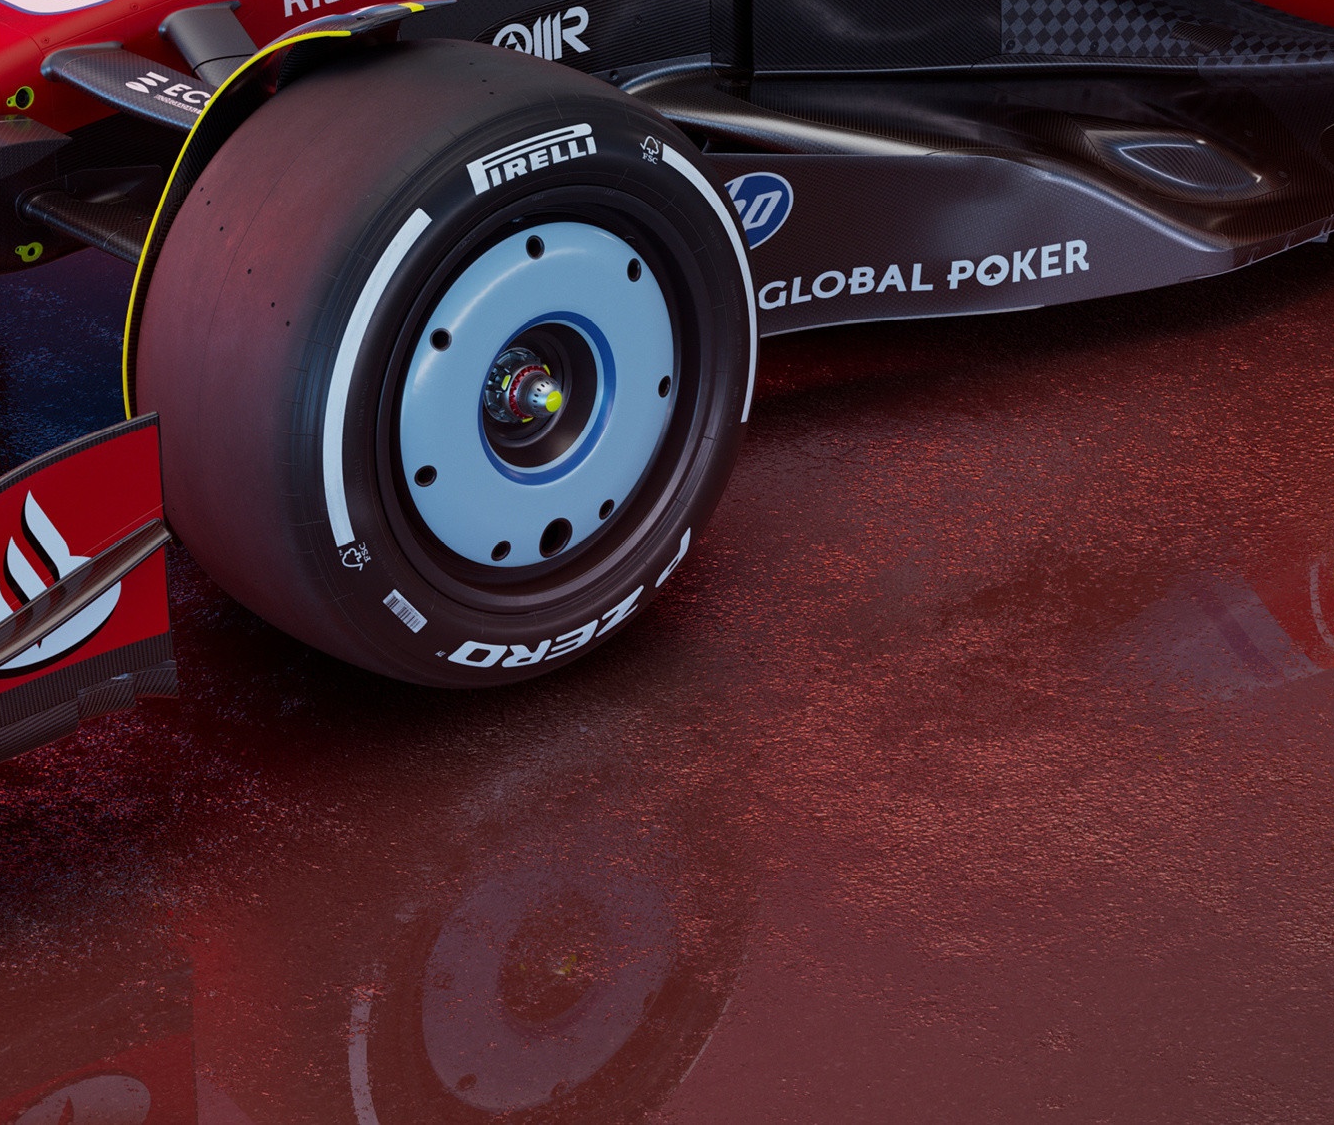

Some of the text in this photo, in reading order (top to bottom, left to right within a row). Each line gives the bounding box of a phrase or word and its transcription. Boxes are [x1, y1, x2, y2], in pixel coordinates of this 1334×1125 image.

[163, 83, 212, 107] EC
[467, 122, 597, 196] PIRELLI
[642, 152, 658, 165] FSC
[758, 263, 933, 310] GLOBAL
[947, 239, 1090, 290] POKER
[448, 585, 645, 668] ZERO
